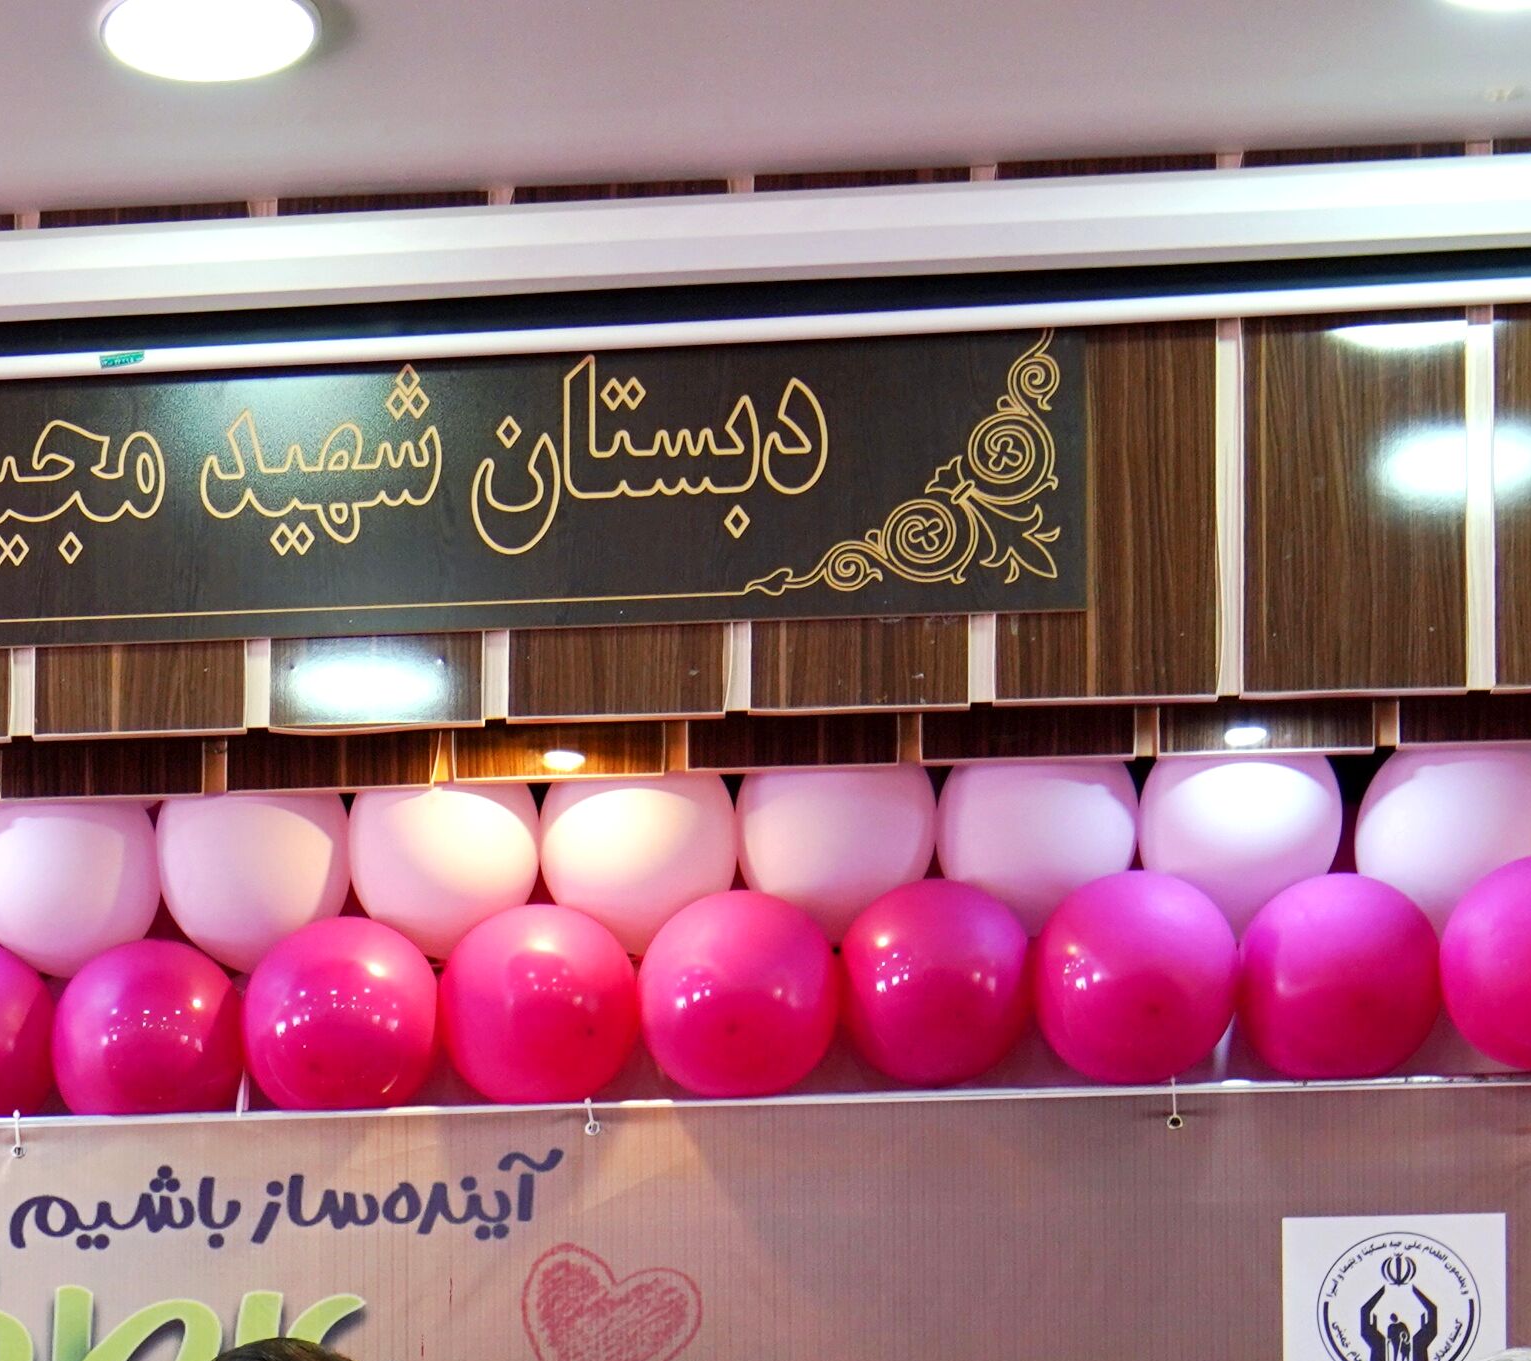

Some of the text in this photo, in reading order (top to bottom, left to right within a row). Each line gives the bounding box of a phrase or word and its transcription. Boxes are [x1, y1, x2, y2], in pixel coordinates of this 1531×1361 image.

[200, 363, 442, 556] شهید
[471, 354, 829, 555] دبستان
[9, 1165, 242, 1250] باشیم
